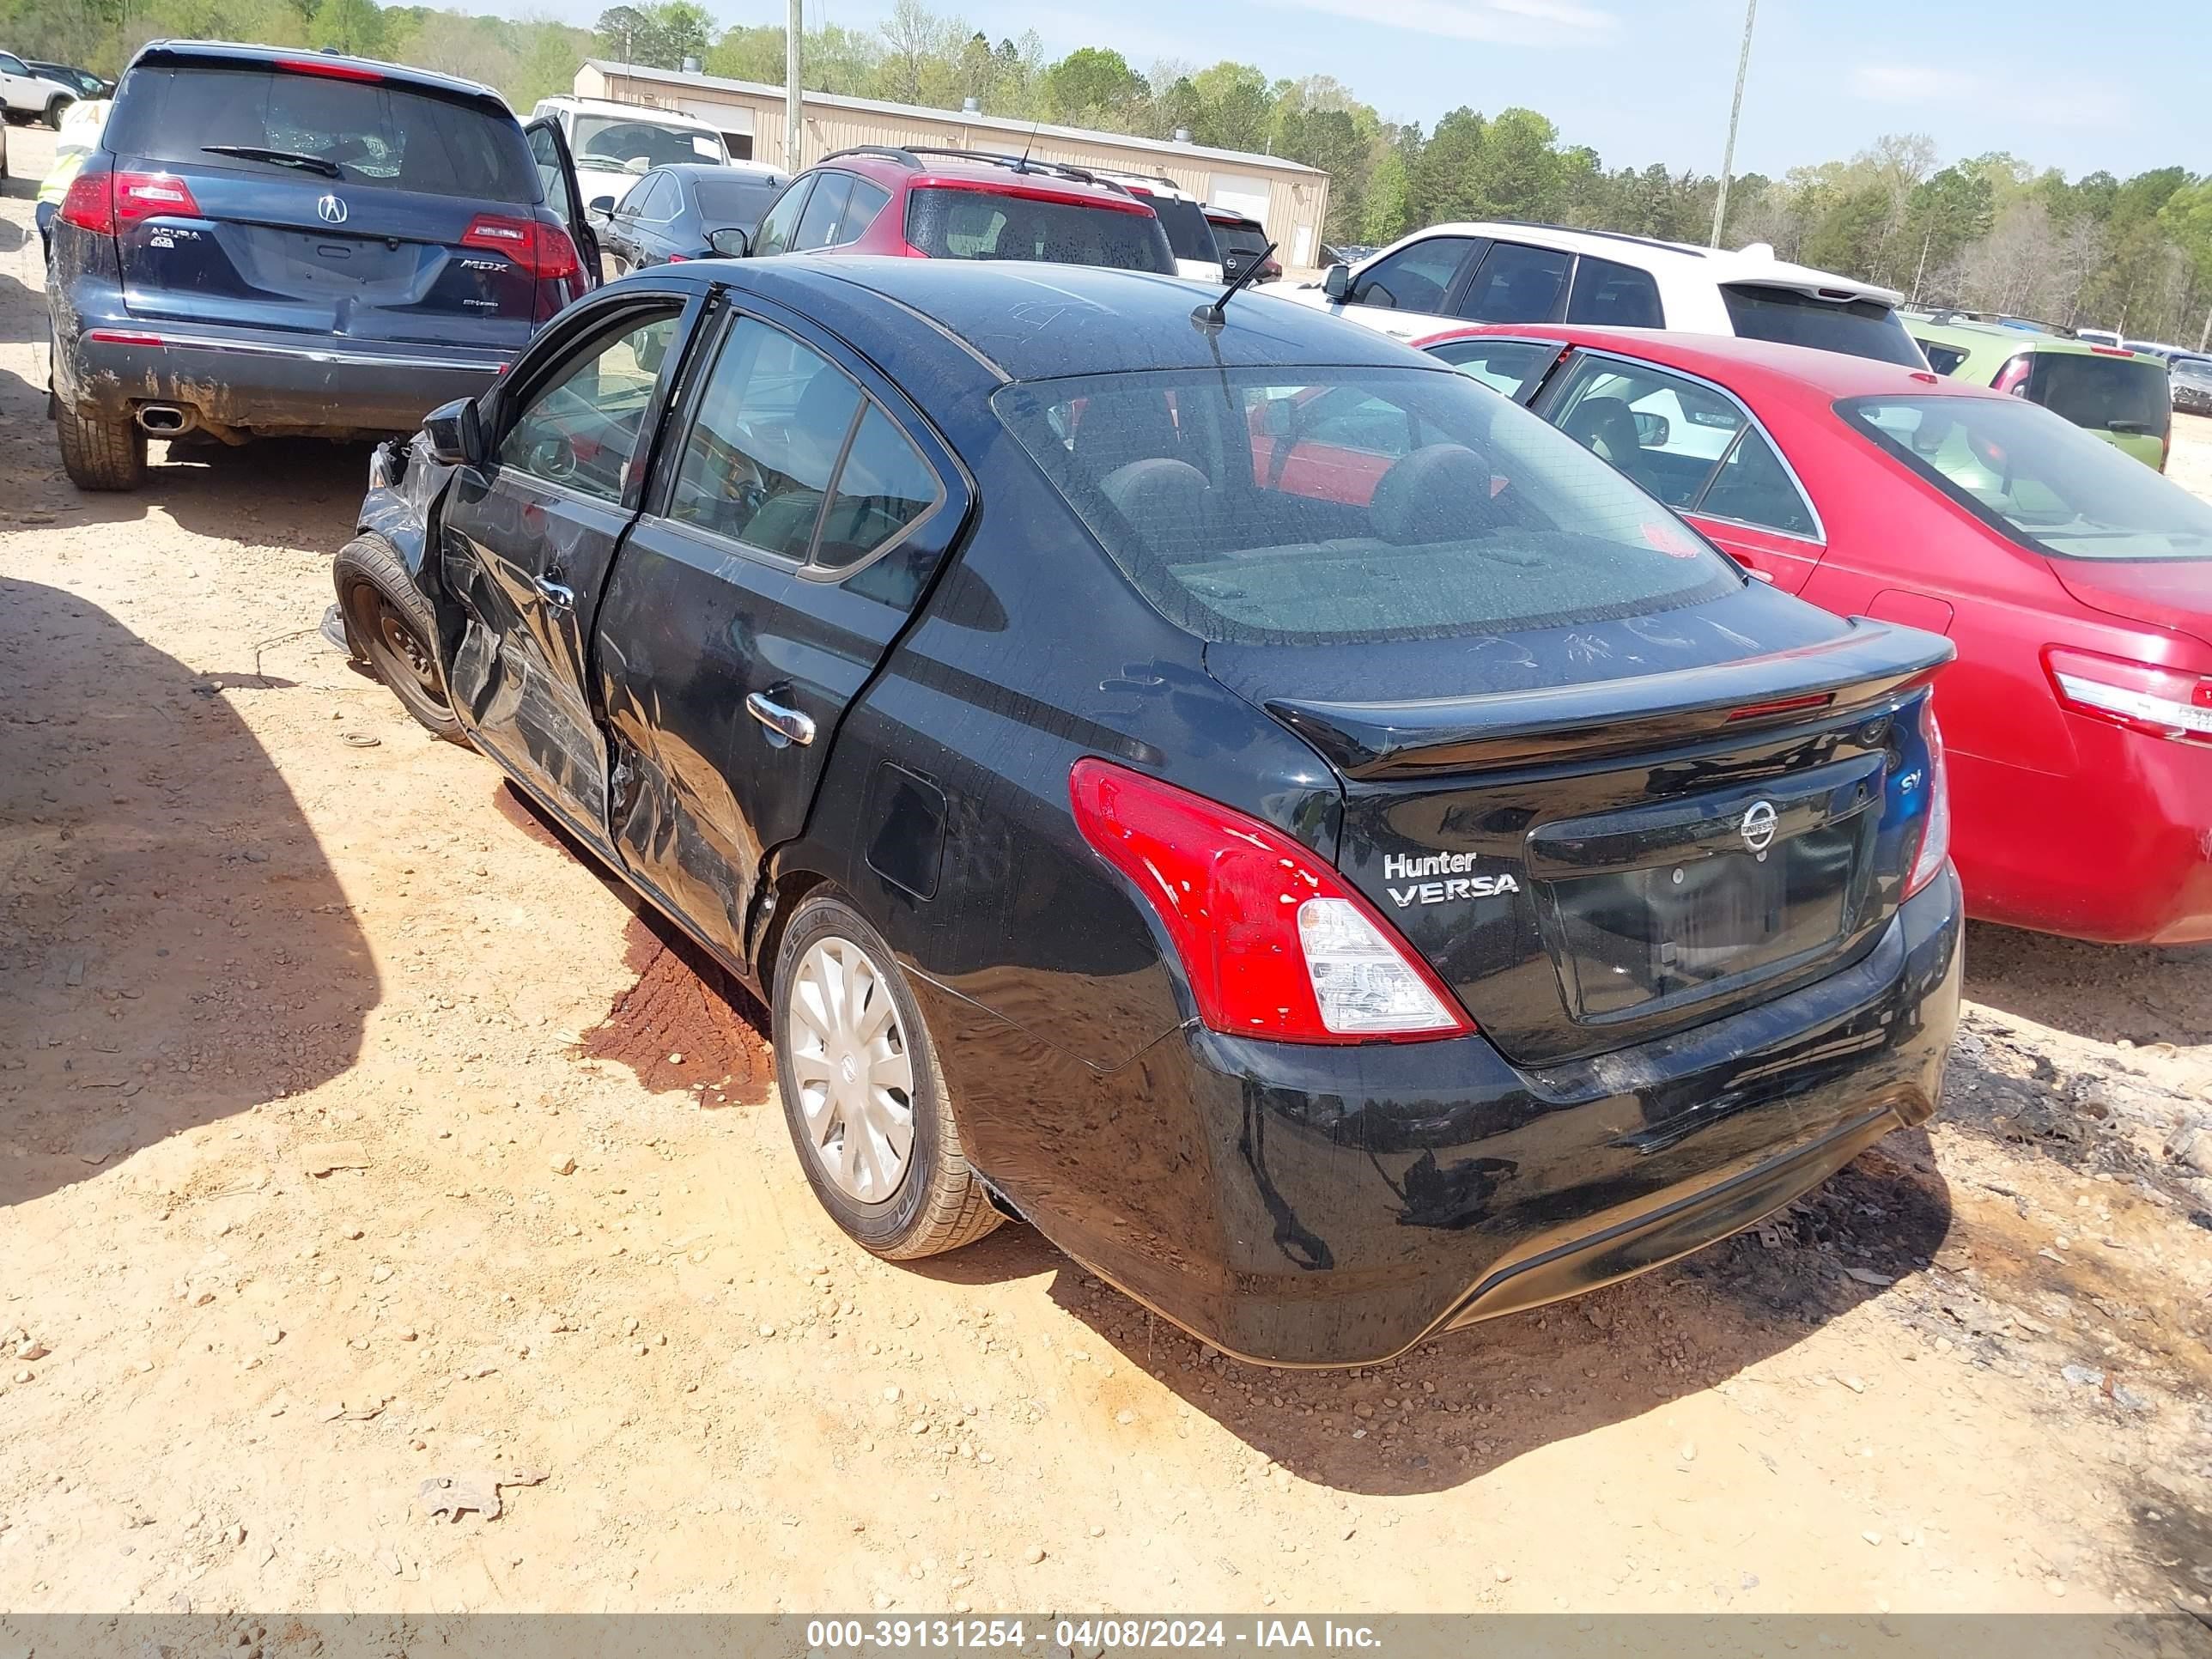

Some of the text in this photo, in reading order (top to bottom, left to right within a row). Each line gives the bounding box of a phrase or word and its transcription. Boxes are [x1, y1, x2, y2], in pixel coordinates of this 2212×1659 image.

[151, 227, 202, 240] ACURA
[460, 259, 508, 271] MDX
[1384, 851, 1477, 879] Hunter
[1387, 873, 1520, 908] VERSA
